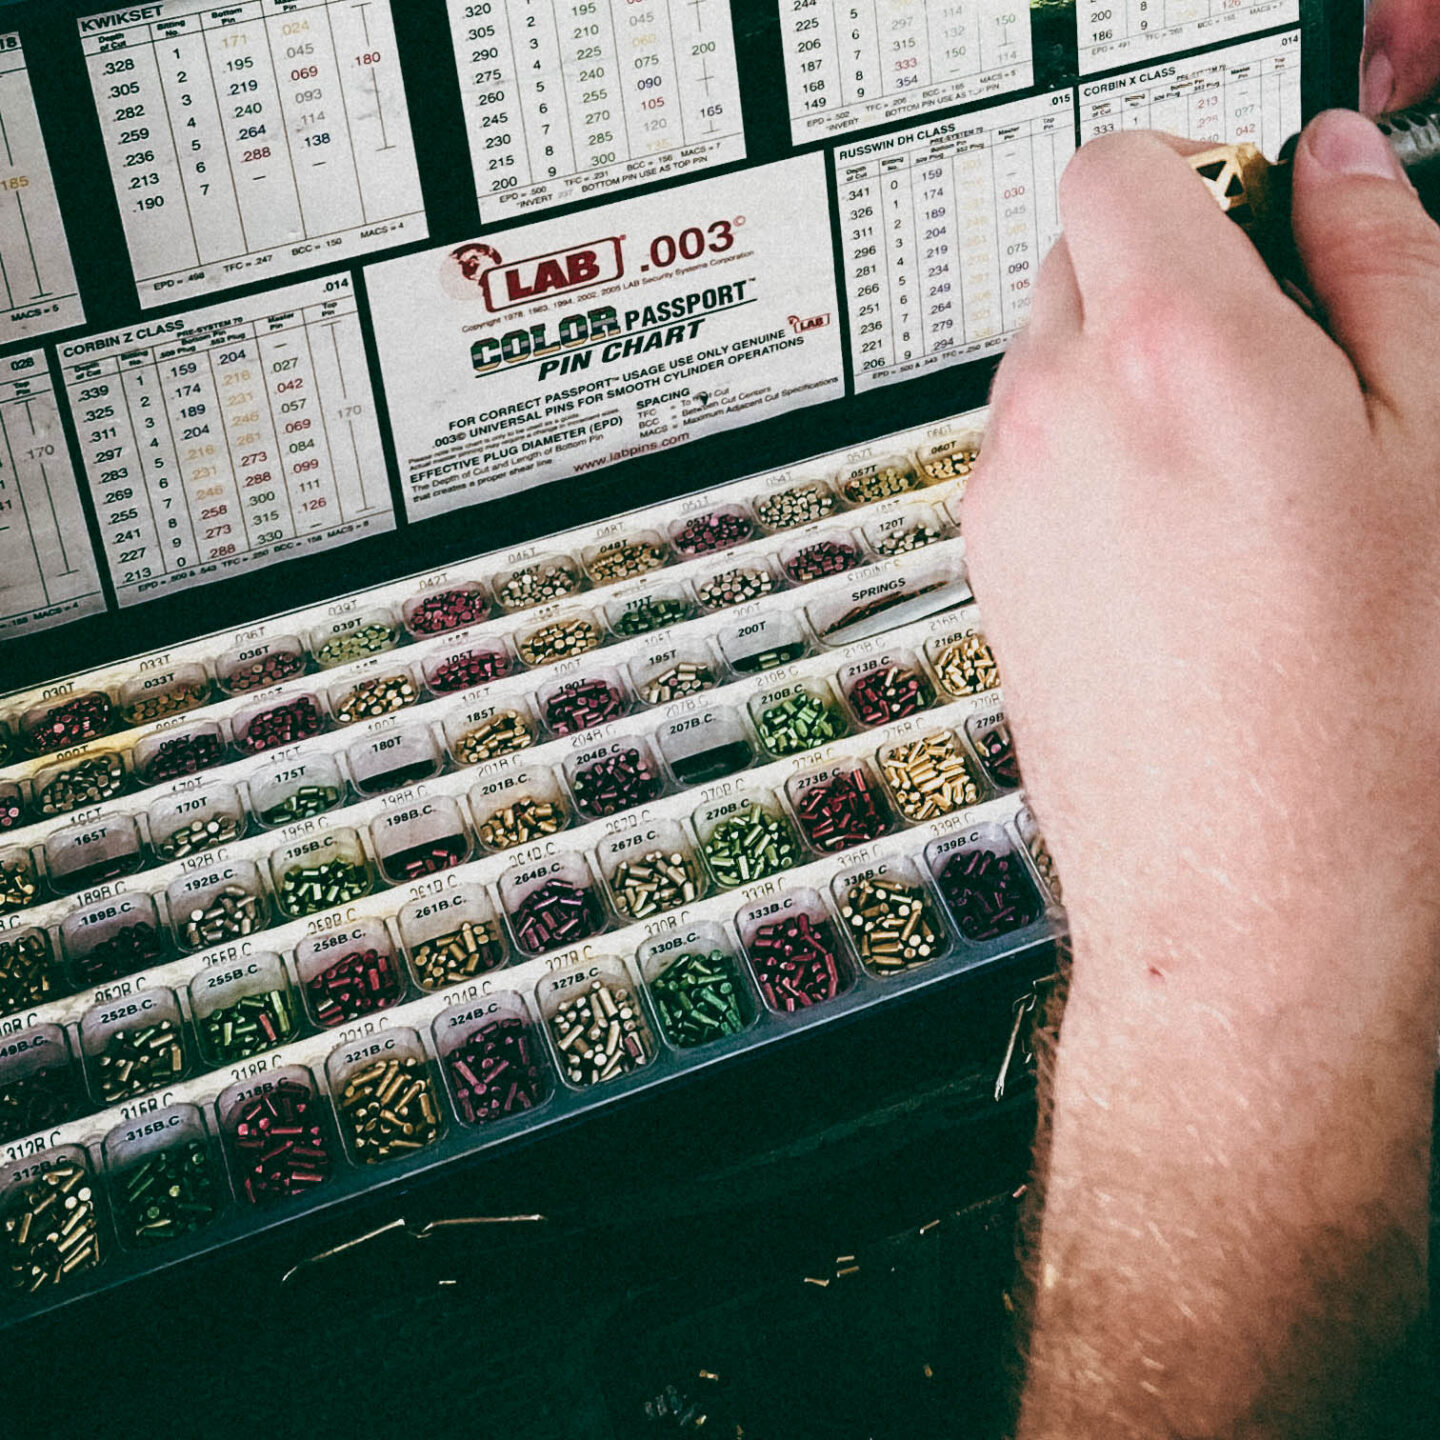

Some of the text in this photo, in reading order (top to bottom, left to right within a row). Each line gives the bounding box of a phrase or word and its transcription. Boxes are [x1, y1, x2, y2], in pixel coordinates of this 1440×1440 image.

[80, 4, 164, 33] KWIKSET
[102, 58, 136, 76] .328
[1084, 79, 1126, 96] CORBIN
[1139, 66, 1176, 82] CLASS
[113, 104, 146, 123] .282
[118, 127, 150, 146] .259
[839, 138, 895, 161] RUSSWIN
[897, 134, 915, 146] DH
[916, 123, 956, 141] CLASS
[123, 150, 156, 168] .236
[128, 172, 160, 191] .213
[133, 195, 165, 213] .190
[505, 250, 601, 302] LAB
[63, 335, 121, 358] CORBIN
[123, 332, 134, 344] Z
[135, 319, 185, 340] CLASS
[322, 278, 349, 293] .014
[470, 305, 624, 373] COLOR
[537, 349, 592, 382] PIN
[597, 317, 706, 364] CHART
[449, 416, 477, 431] FOR
[479, 397, 542, 423] CORRECT
[622, 363, 667, 383] USAGE
[669, 354, 694, 370] USE
[697, 345, 729, 361] ONLY
[731, 329, 786, 352] GENUINE
[469, 411, 543, 438] UNIVERSAL
[545, 401, 575, 417] PINS
[577, 393, 604, 408] FOR
[606, 377, 661, 399] SMOOTH
[663, 359, 725, 383] CYLINDER
[727, 336, 805, 365] OPERATIONS
[78, 384, 110, 403] .339
[636, 387, 691, 410] SPACING
[83, 405, 115, 424] .325
[88, 426, 117, 444] .311
[93, 446, 123, 465] .297
[410, 415, 624, 484] EFFECTIVE PLUG DIAMETER (EPD)
[411, 434, 604, 493] The Depth of Cut and Length of Bottom Pin
[98, 467, 129, 485] .283
[477, 472, 507, 486] proper
[509, 463, 535, 476] shear
[103, 487, 134, 505] .269
[108, 507, 139, 526] .255
[112, 528, 141, 545] .241
[117, 546, 147, 565] .227
[122, 567, 153, 584] .213
[852, 577, 907, 602] SPRINGS
